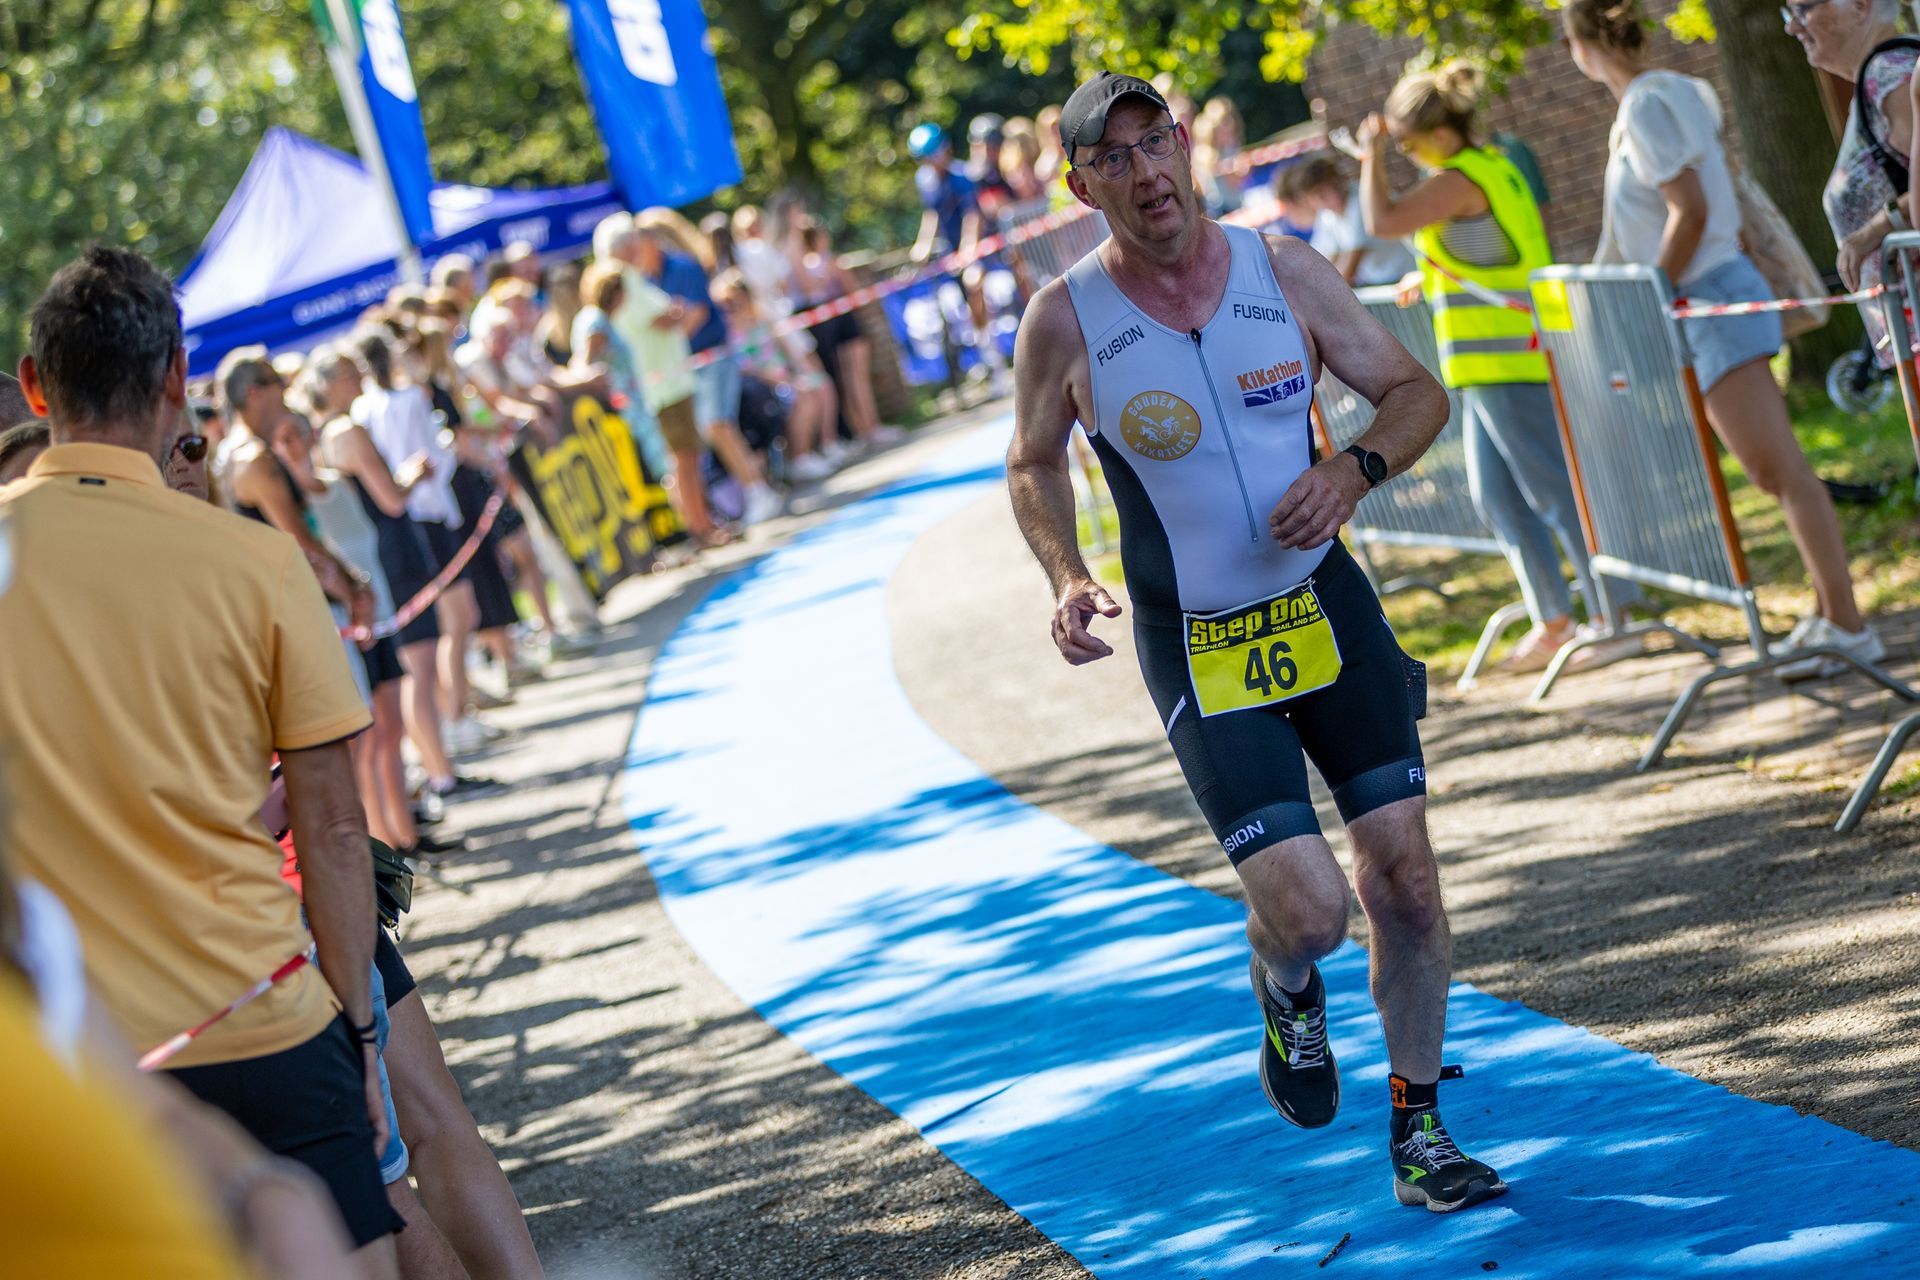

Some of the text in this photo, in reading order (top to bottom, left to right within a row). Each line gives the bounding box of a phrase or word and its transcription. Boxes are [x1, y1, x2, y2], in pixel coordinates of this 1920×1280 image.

[1233, 304, 1286, 324] FUSION
[1096, 325, 1145, 366] FUSION
[1236, 360, 1303, 391] KiKathlon
[1128, 394, 1178, 416] GOUDEN
[1133, 430, 1197, 459] KIKATLEET
[1190, 592, 1318, 645] Step One
[1271, 612, 1321, 633] TRAIL AND RUN
[1190, 640, 1229, 654] TRIATHLON
[1244, 641, 1298, 697] 46
[1408, 767, 1426, 783] FU
